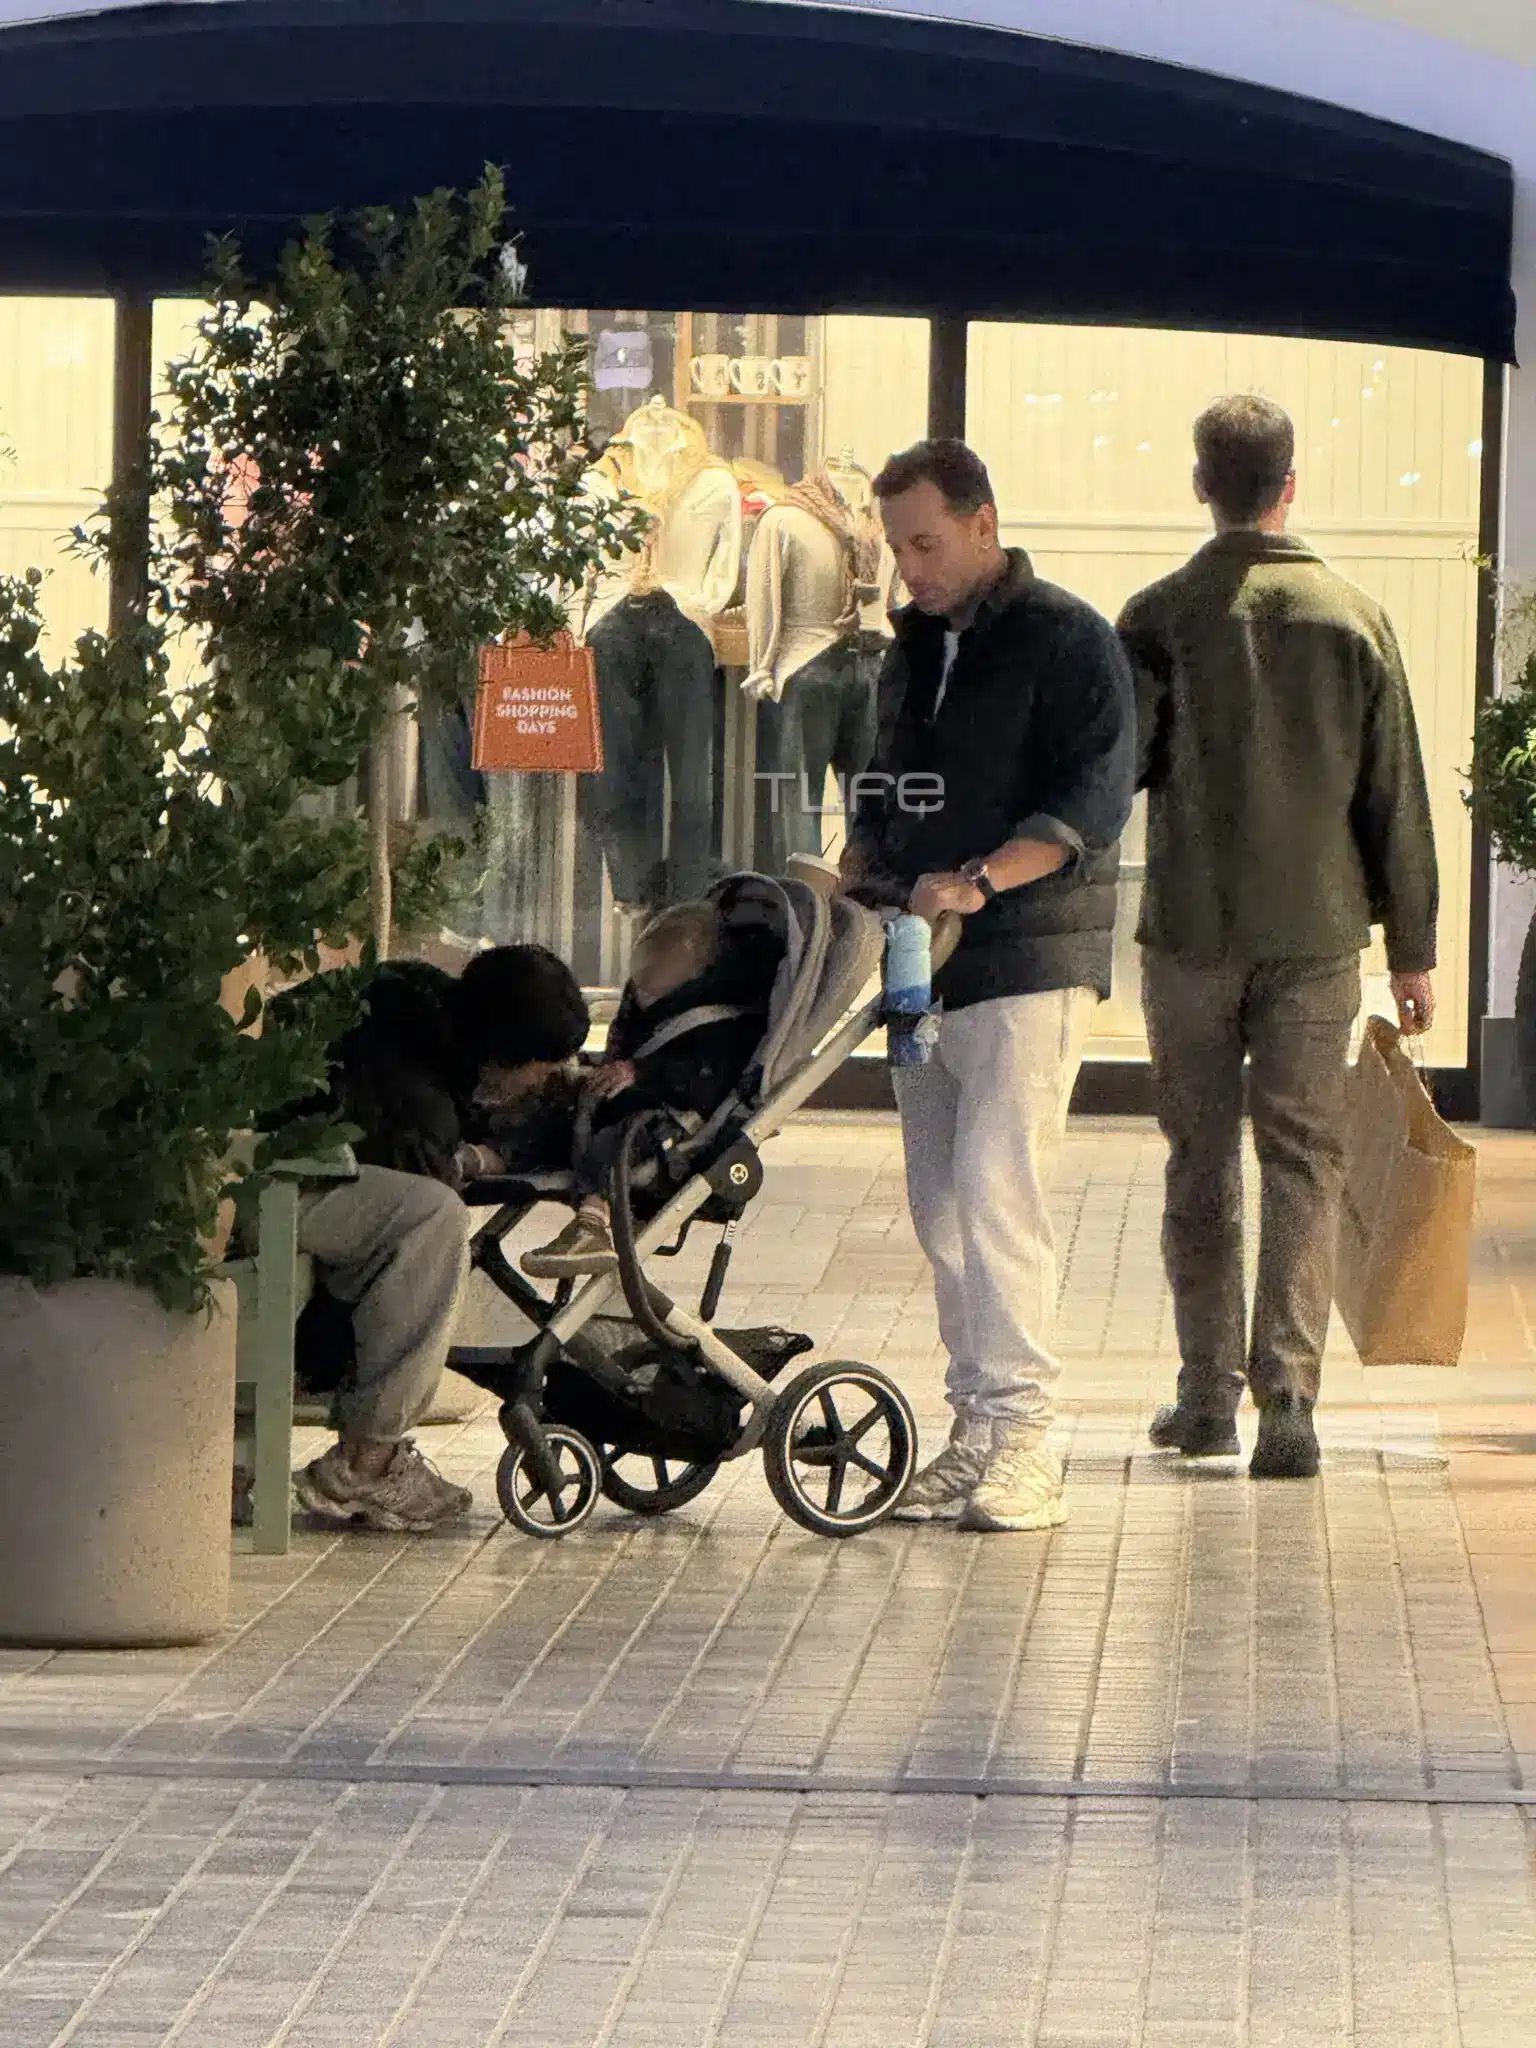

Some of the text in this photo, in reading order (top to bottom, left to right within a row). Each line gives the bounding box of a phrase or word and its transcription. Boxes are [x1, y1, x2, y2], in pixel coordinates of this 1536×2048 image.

[502, 686, 573, 701] FASHION
[495, 703, 578, 719] SHOPPING
[516, 720, 557, 734] DAYS
